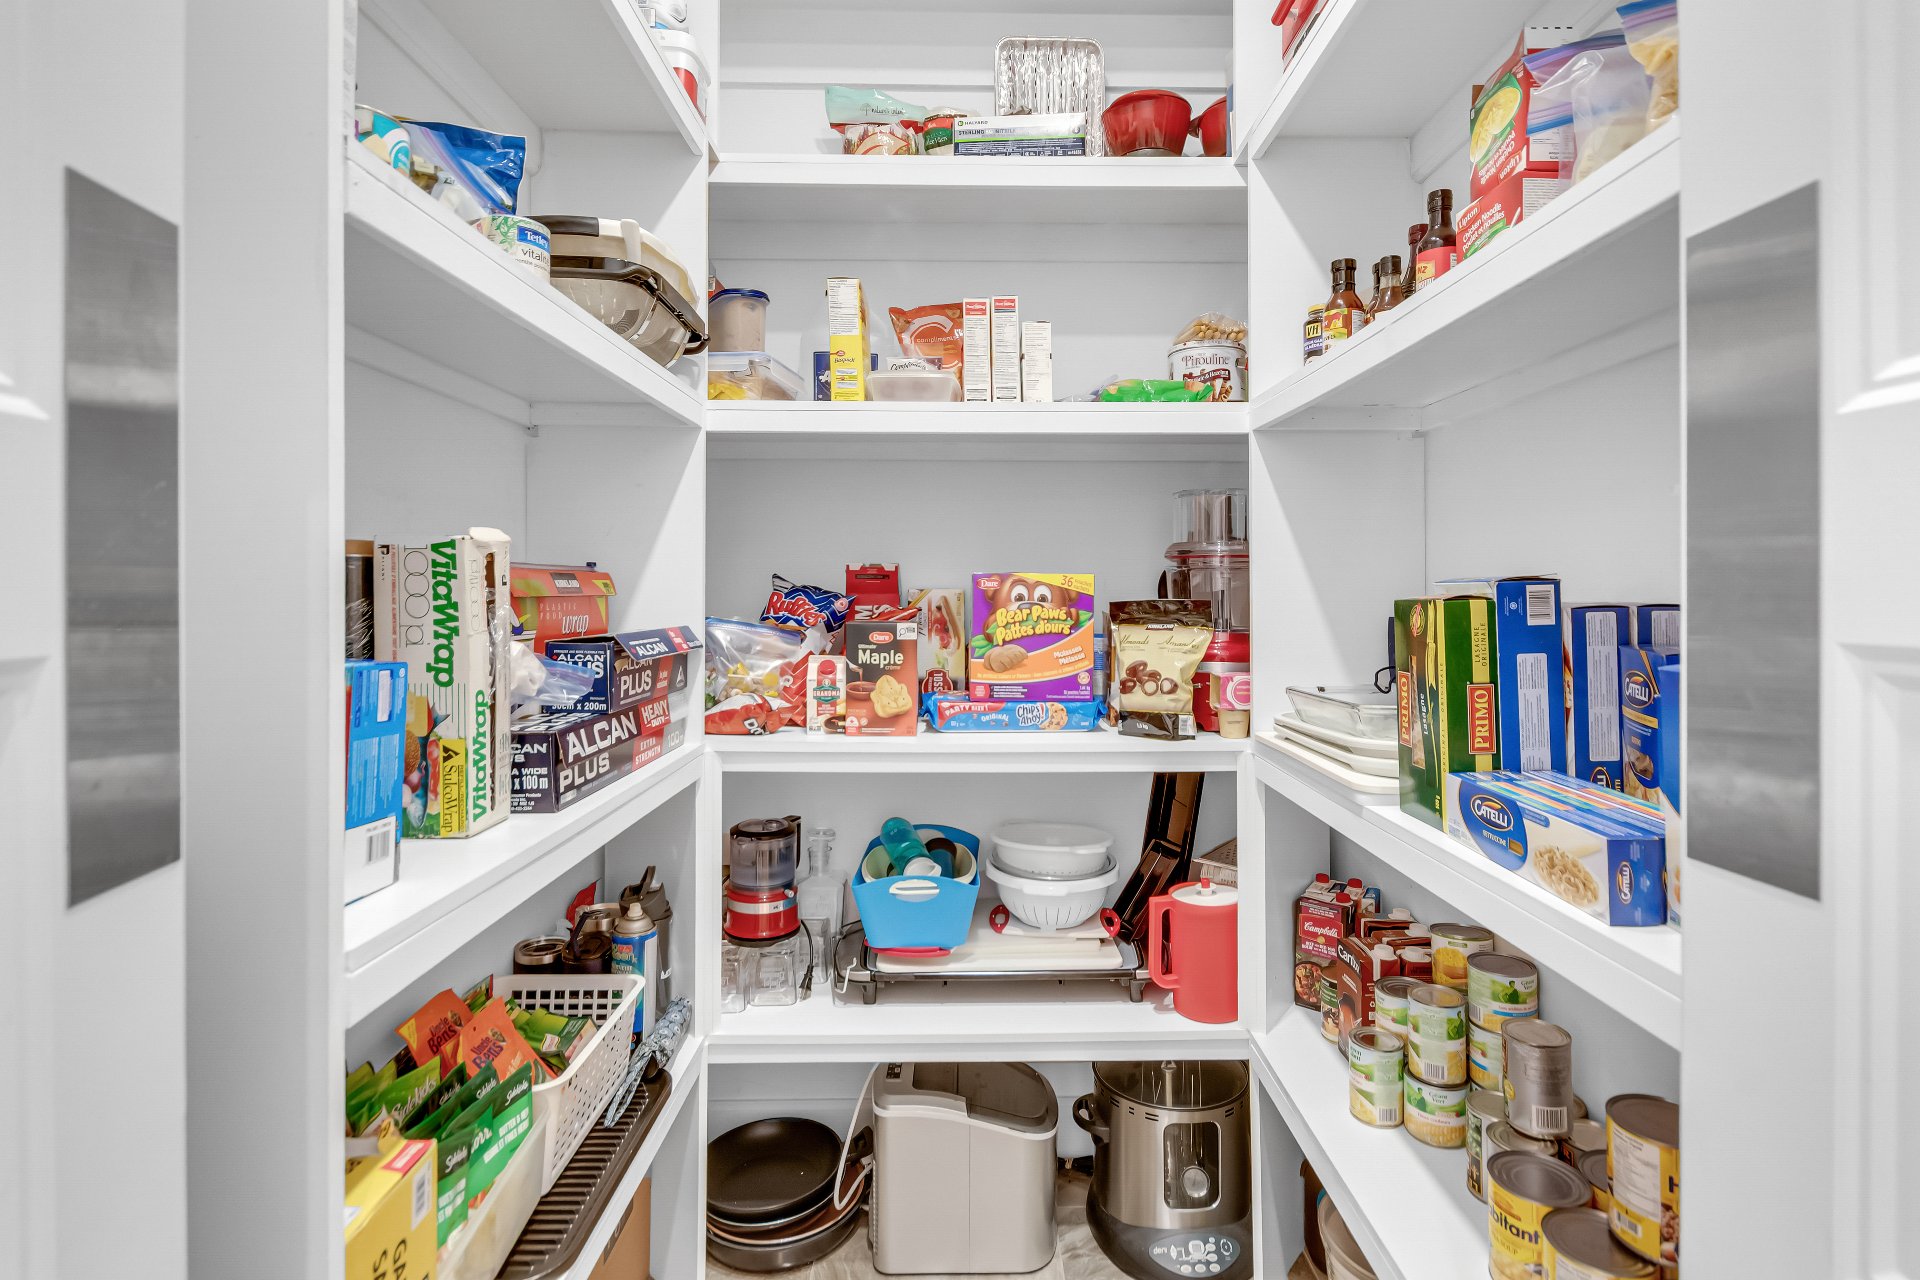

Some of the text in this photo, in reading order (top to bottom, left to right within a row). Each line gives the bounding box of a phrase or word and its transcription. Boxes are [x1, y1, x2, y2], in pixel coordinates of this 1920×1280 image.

[1458, 207, 1478, 229] Lipton
[1463, 203, 1502, 243] Chicken Noodle
[525, 230, 548, 249] Tetley
[1462, 231, 1479, 253] poulet
[1307, 325, 1320, 336] VH
[1182, 353, 1230, 367] Pirouline
[403, 544, 431, 619] 1000
[981, 579, 999, 588] Dare
[1060, 575, 1073, 588] 36
[425, 539, 460, 688] VitaWrap
[540, 602, 577, 611] PLASTIC
[540, 612, 562, 620] FOOD
[766, 592, 827, 627] Ruffles
[996, 605, 1067, 627] Bear Paws
[562, 614, 589, 637] wrap
[996, 620, 1071, 646] Pattes d'ours
[873, 633, 890, 642] Dare
[557, 654, 604, 662] ALCAN
[635, 642, 669, 657] ALCAN
[858, 649, 904, 669] Maple
[1053, 646, 1083, 659] Molasses
[620, 672, 652, 698] PLUS
[1625, 677, 1649, 702] CATELLI
[584, 702, 607, 711] 200m
[641, 699, 669, 725] HEAVY
[945, 704, 970, 716] PARTY
[1400, 677, 1410, 742] PRIMO
[1420, 693, 1428, 735] Lasagne
[651, 718, 665, 728] DUTY
[981, 713, 1010, 722] ORIGINAL
[1474, 688, 1490, 750] PRIMO
[568, 711, 638, 763] ALCAN
[640, 737, 657, 751] EXTRA
[472, 689, 491, 823] VitaWrap
[510, 743, 548, 754] CAN
[635, 744, 661, 765] STRENGTH
[522, 767, 548, 775] WIDE
[559, 752, 611, 794] PLUS
[513, 778, 520, 790] x
[522, 775, 538, 790] 100
[441, 765, 458, 833] SulcoWrap
[1474, 799, 1508, 828] CATELLI
[1620, 866, 1631, 900] CATELLI
[428, 1016, 449, 1037] Uncle
[470, 1035, 492, 1056] Uncle
[1489, 1207, 1540, 1245] bitant
